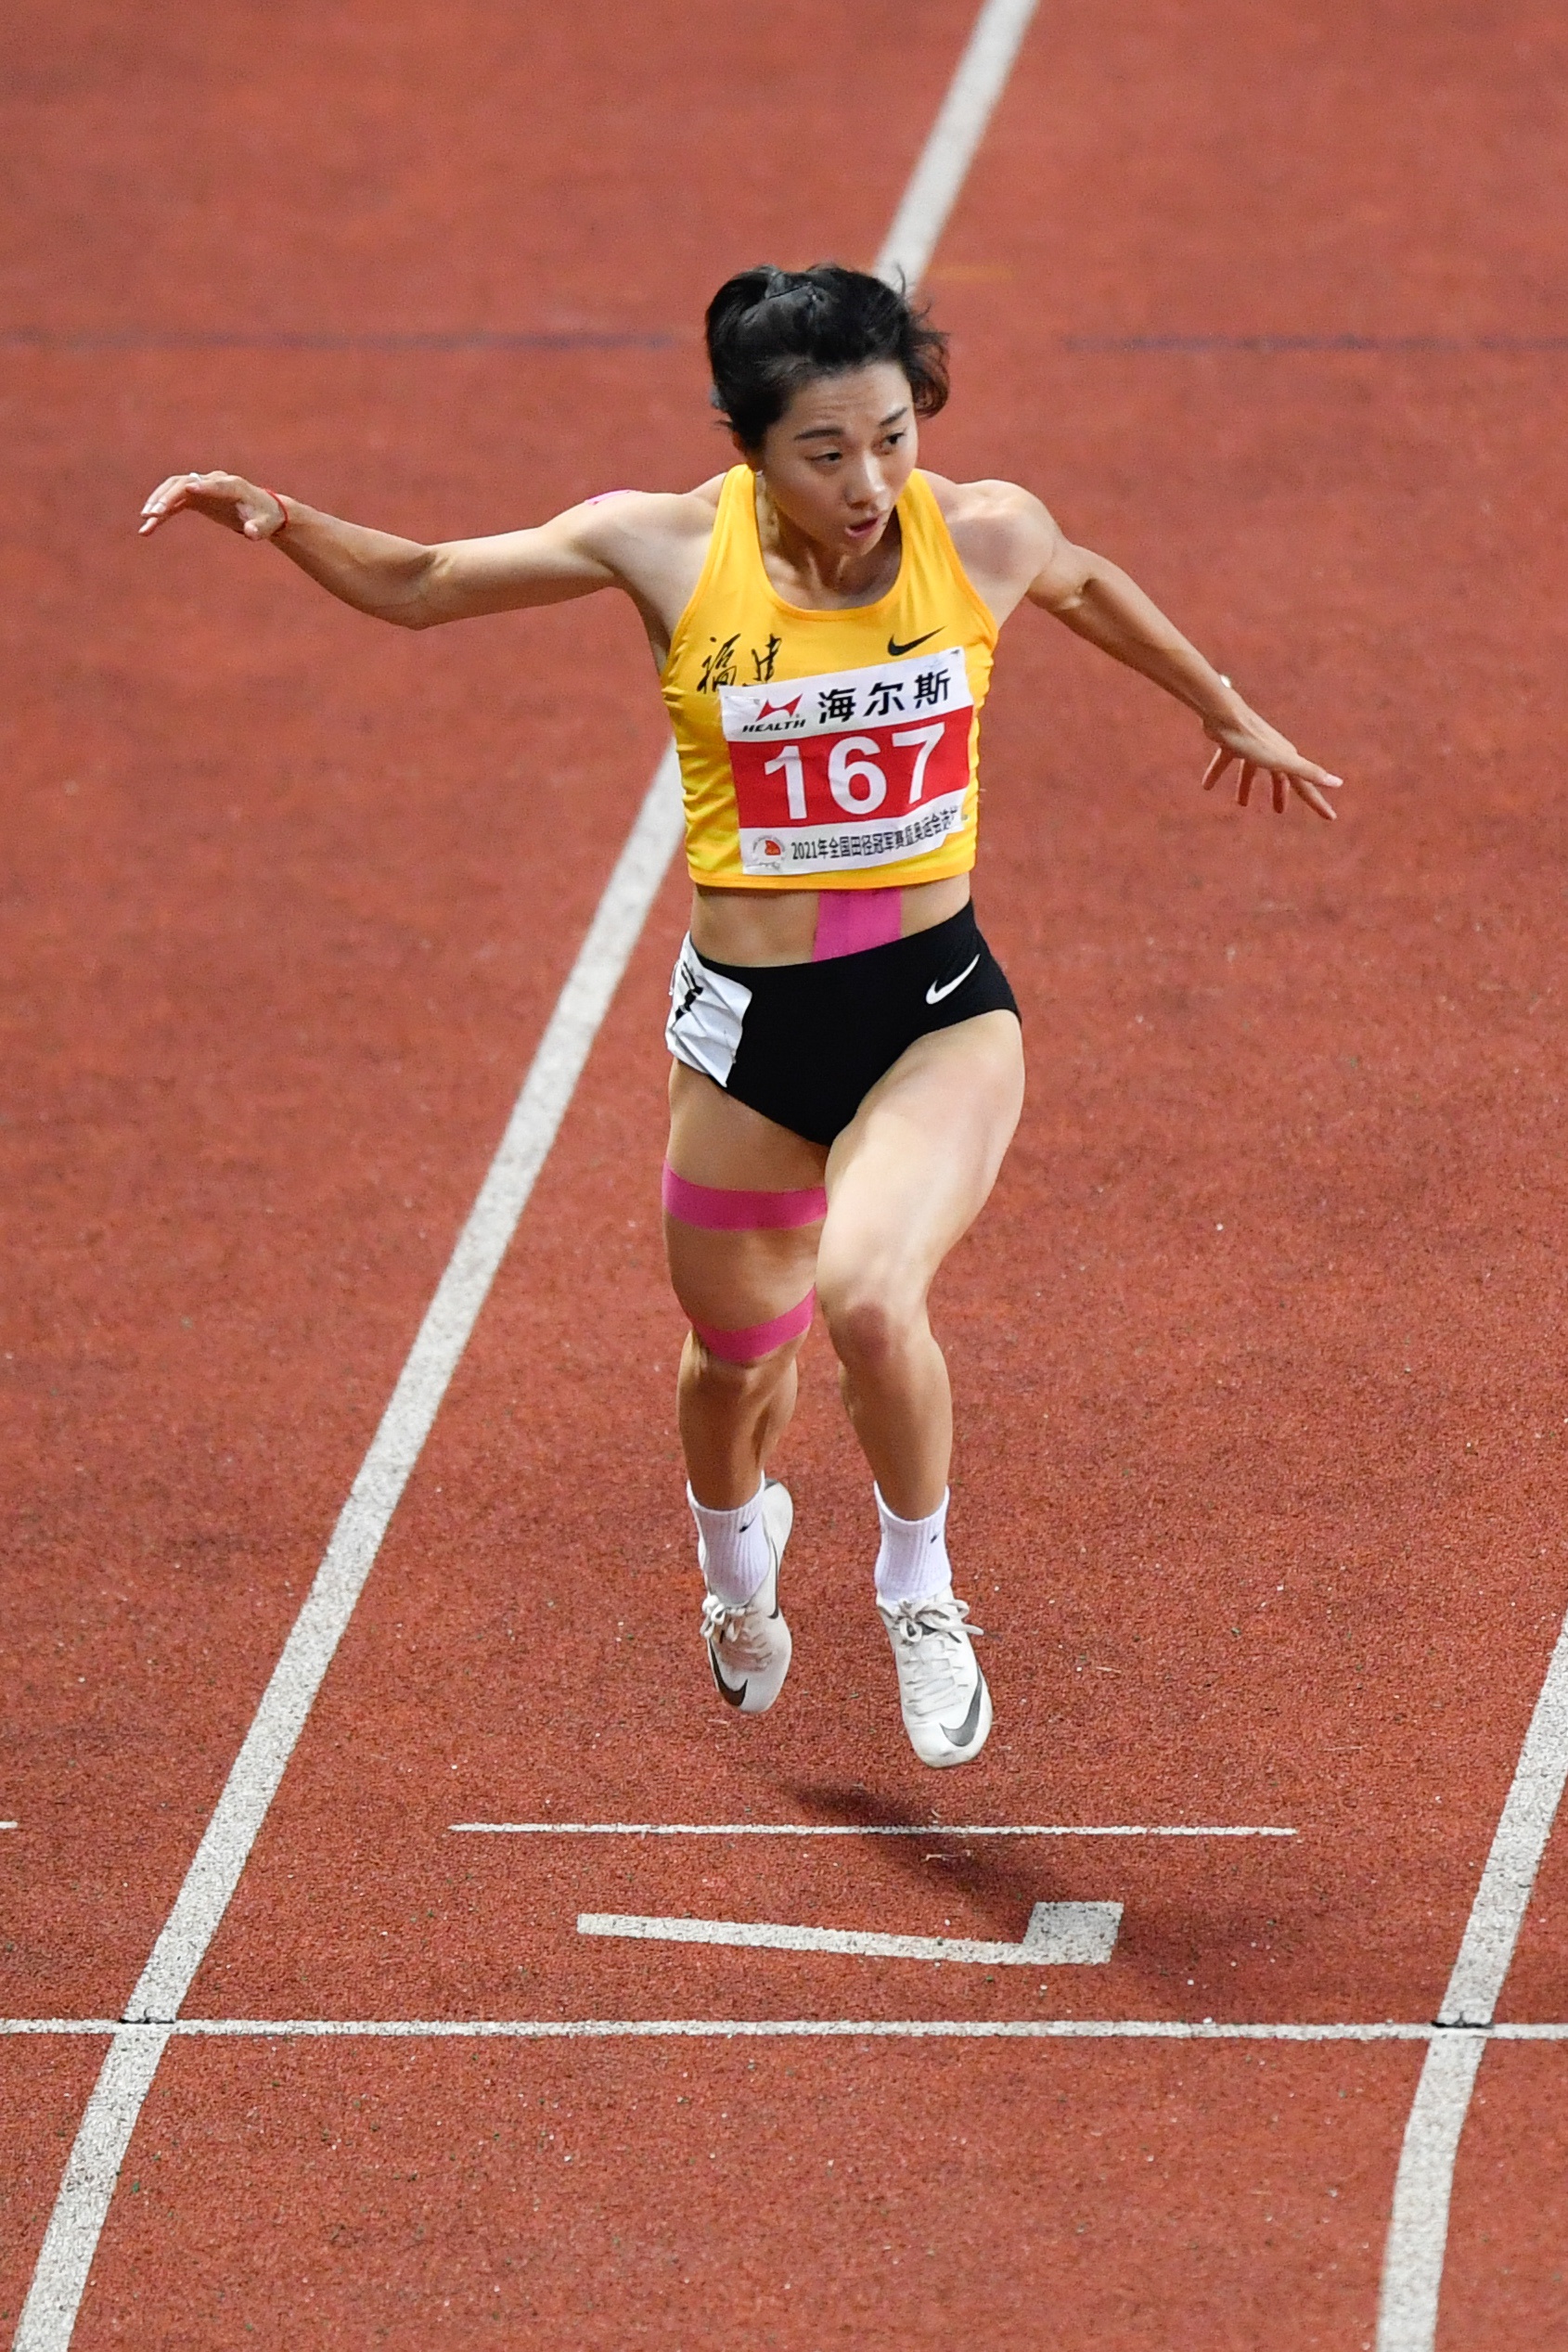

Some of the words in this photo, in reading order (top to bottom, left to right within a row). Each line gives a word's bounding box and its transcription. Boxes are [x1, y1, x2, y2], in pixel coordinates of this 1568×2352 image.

[818, 668, 951, 725] 海尔斯
[742, 719, 806, 733] HEALTH
[765, 722, 945, 820] 167
